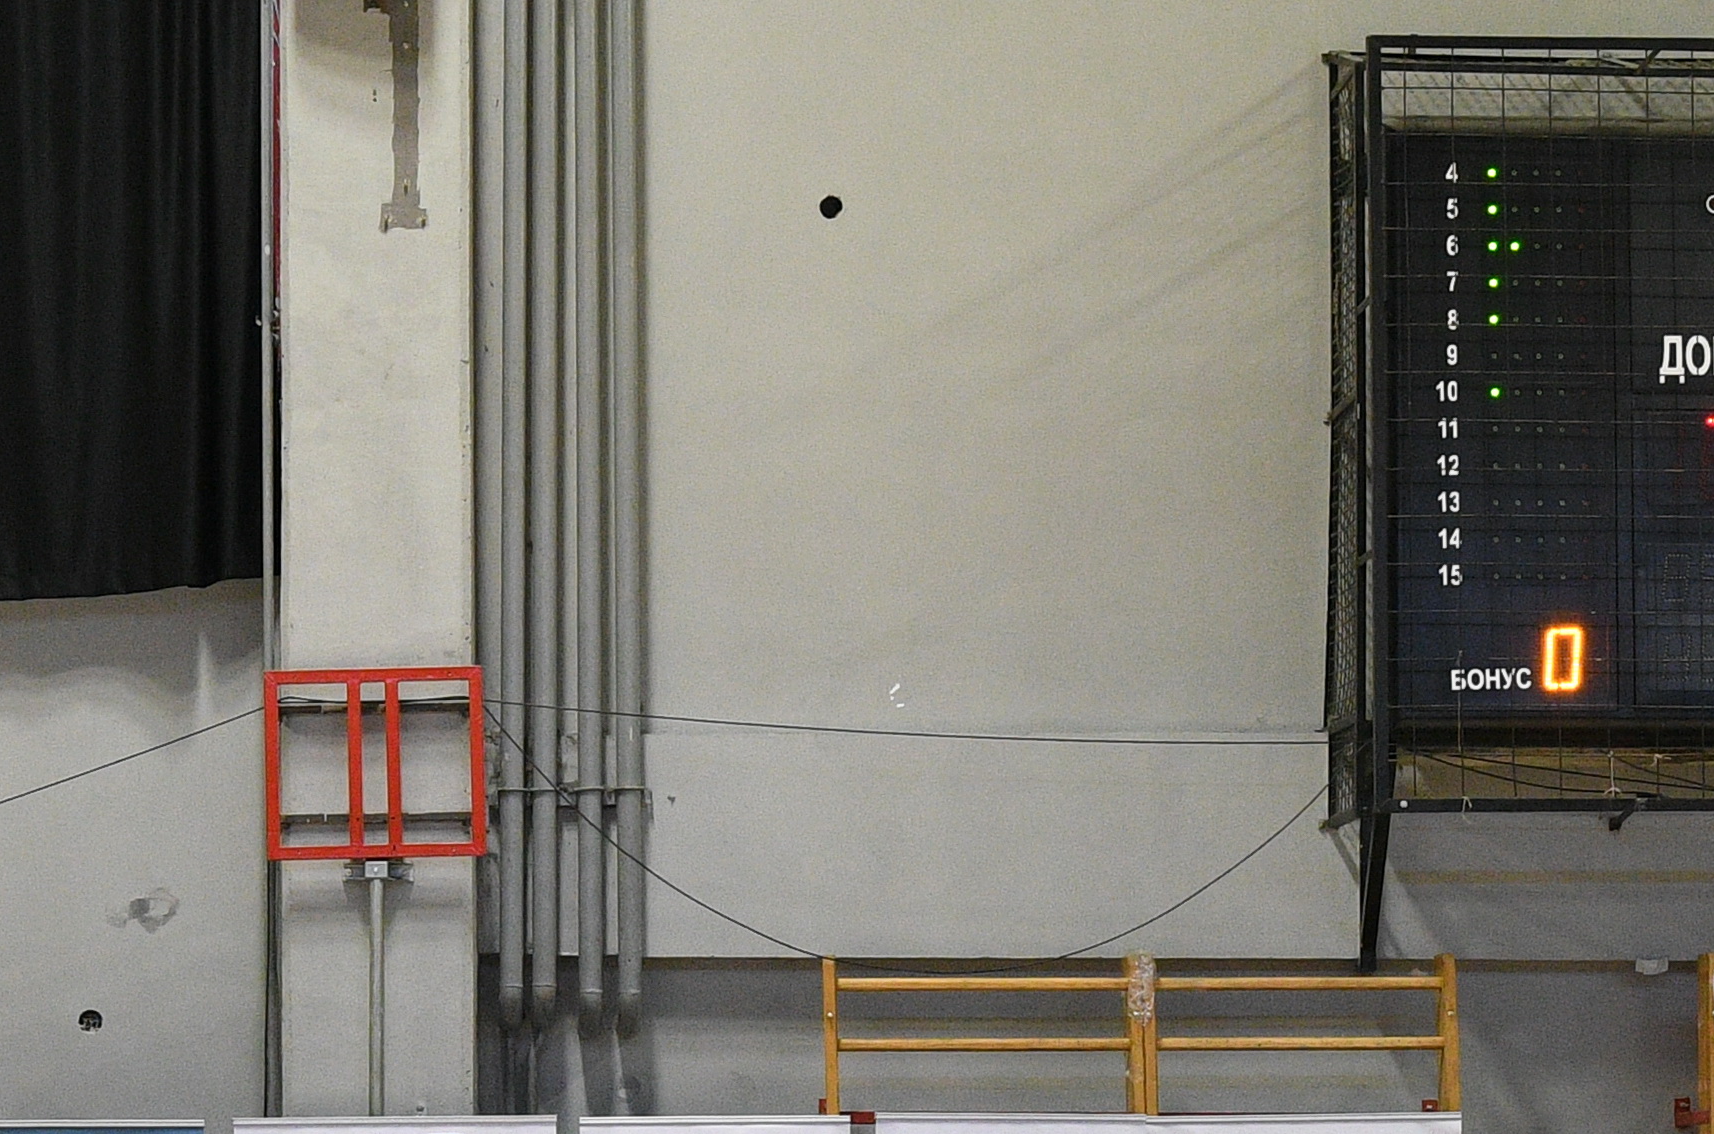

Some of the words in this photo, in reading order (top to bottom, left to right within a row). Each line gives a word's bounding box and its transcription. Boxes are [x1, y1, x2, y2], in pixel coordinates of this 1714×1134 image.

[1445, 162, 1458, 183] 4
[1446, 198, 1459, 219] 5
[1446, 235, 1459, 256] 6
[1446, 271, 1459, 292] 7
[1447, 309, 1459, 330] 8
[1446, 344, 1458, 365] 9
[1436, 381, 1458, 402] 10
[1438, 418, 1458, 439] 11
[1437, 455, 1459, 476] 12
[1438, 491, 1460, 512] 13
[1438, 528, 1461, 549] 14
[1439, 565, 1462, 585] 15
[1451, 667, 1532, 690] БОНУС
[1542, 626, 1583, 692] 0
